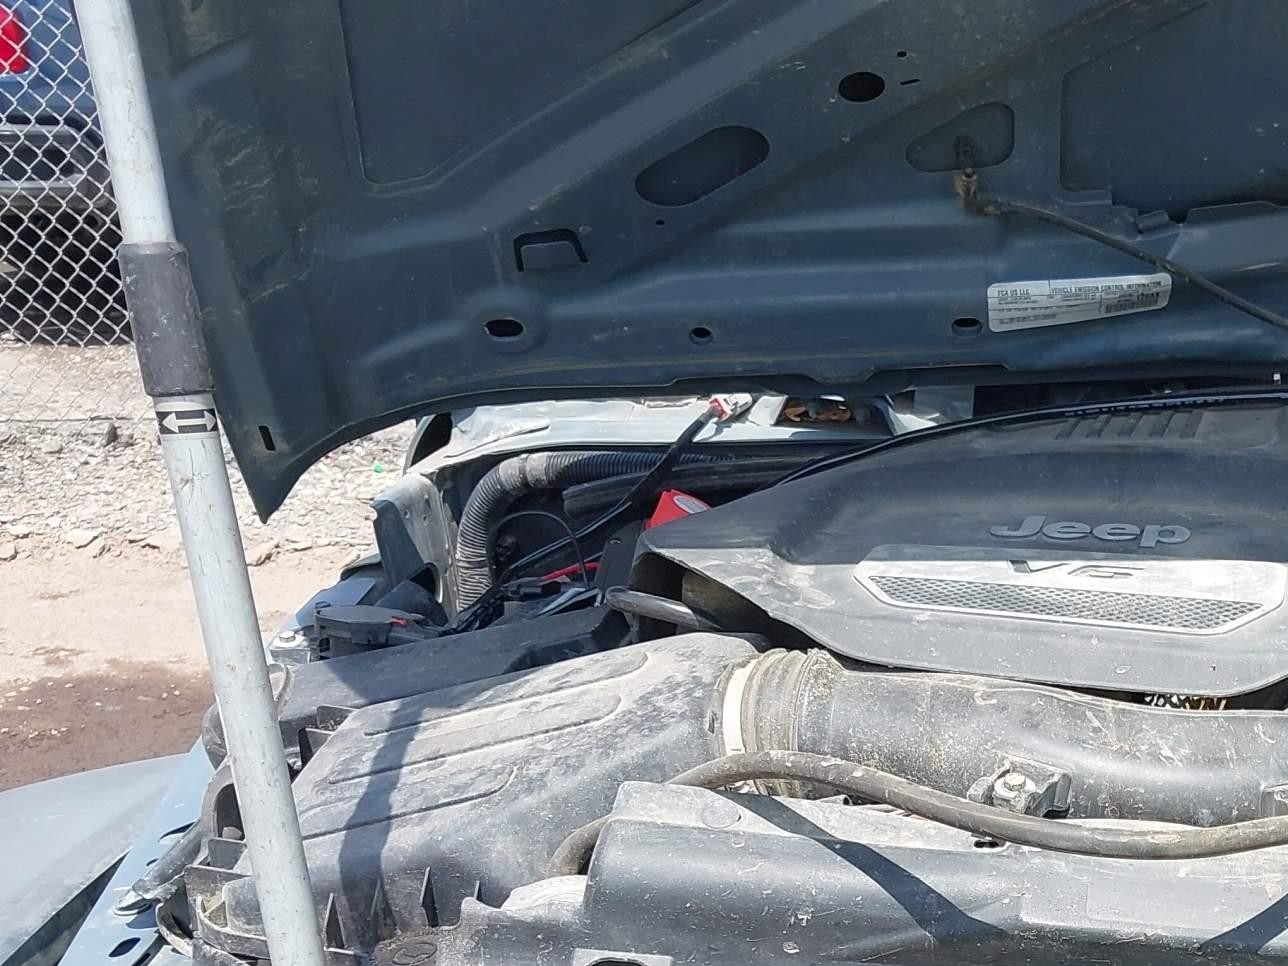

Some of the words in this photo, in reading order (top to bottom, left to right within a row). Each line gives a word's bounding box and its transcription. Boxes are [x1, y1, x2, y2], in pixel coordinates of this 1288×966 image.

[1019, 288, 1030, 296] LLC
[1051, 286, 1073, 295] VEHICLE
[1101, 284, 1124, 292] CONTROL
[1126, 281, 1162, 290] INFORMATION
[989, 514, 1192, 548] Jeep
